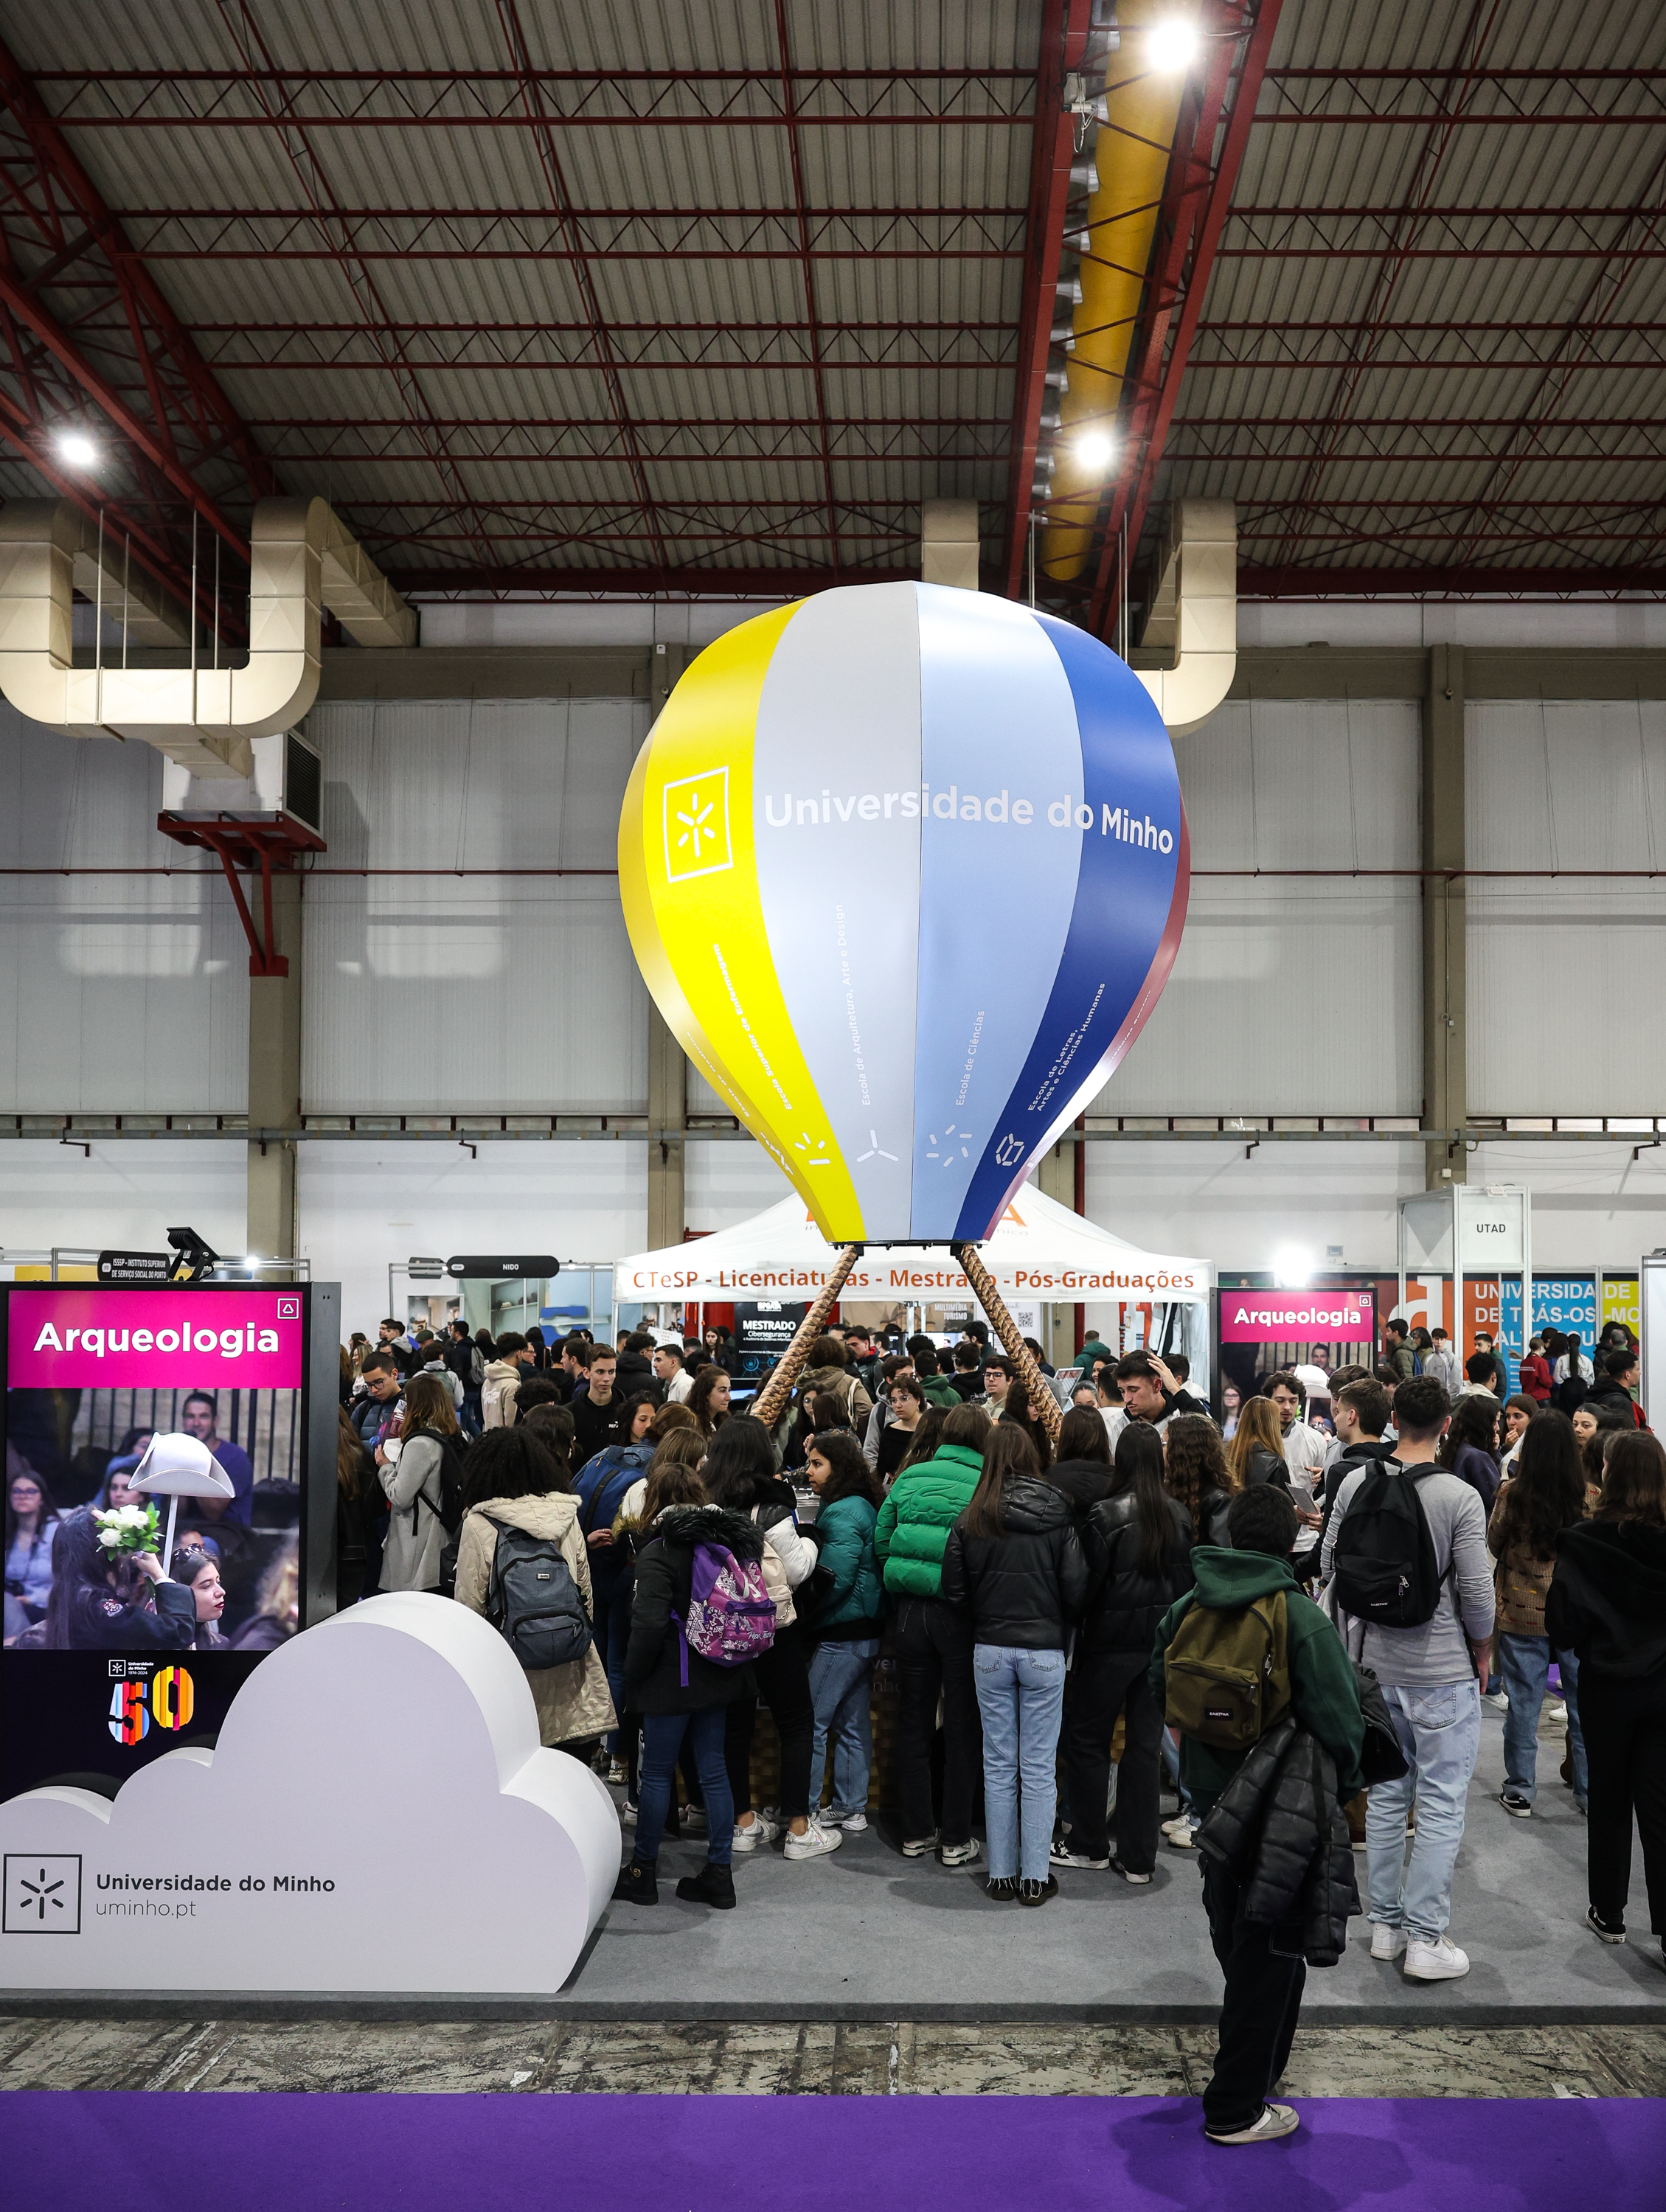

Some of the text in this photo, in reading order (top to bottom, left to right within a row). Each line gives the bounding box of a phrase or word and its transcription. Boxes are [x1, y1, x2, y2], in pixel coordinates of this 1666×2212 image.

[764, 782, 1173, 855] Universidade do Minho
[836, 904, 847, 946] Design
[841, 960, 851, 986] Arte
[713, 943, 793, 1110] Escola Superior de Enfermagem
[846, 989, 862, 1054] Arquitetura,
[956, 1010, 985, 1105] Escola de Ciências
[1036, 1086, 1055, 1112] Artes
[1058, 1034, 1083, 1076] Ciências
[1080, 983, 1106, 1032] Humanas
[855, 1057, 864, 1071] de
[1027, 1029, 1078, 1111] Escola de Letras,
[858, 1074, 870, 1105] Escola
[1476, 1224, 1506, 1233] UTAD
[111, 1270, 167, 1279] DE SERVIÇO SOCIAL DO PORTO
[113, 1259, 125, 1267] ISSSP
[128, 1259, 147, 1267] INSTITUTO
[147, 1259, 166, 1268] SUPERIOR
[634, 1271, 698, 1288] CTeSP
[720, 1269, 870, 1287] Licenciatas
[889, 1269, 997, 1287] Mestra
[1015, 1270, 1194, 1293] Pós-Graduações
[743, 1320, 796, 1331] MESTRADO
[943, 1312, 968, 1321] TURISMO
[1234, 1307, 1361, 1327] Arqueologia
[1475, 1307, 1504, 1323] DE
[32, 1321, 279, 1358] Arqueologia
[747, 1330, 791, 1339] Cibersegurança
[108, 1666, 194, 1745] 50
[97, 1874, 336, 1892] Universidade do Minho
[96, 1899, 197, 1919] uminho.pt
